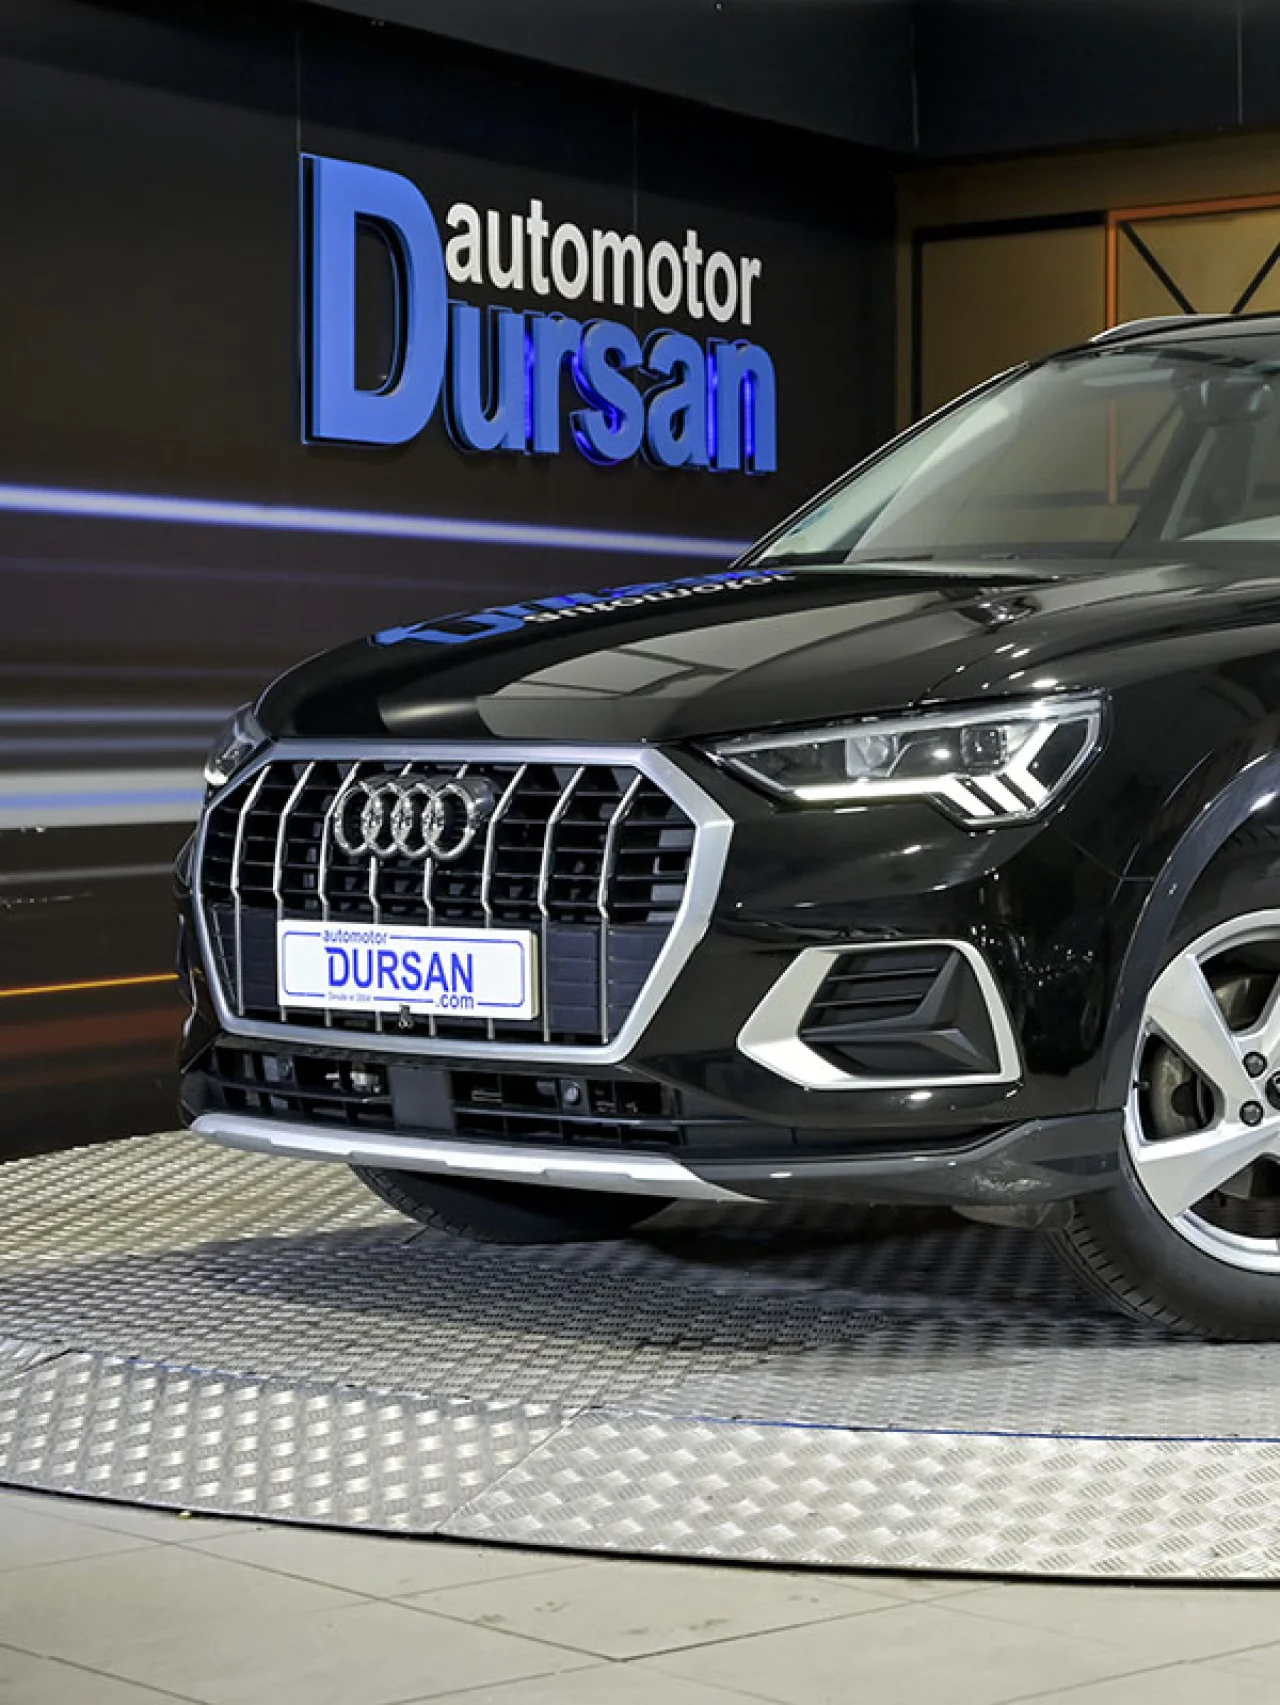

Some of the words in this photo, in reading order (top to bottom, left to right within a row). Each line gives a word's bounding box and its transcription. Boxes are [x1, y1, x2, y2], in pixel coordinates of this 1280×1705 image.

[445, 199, 761, 325] automotor
[301, 153, 777, 475] Dursan
[323, 928, 388, 946] automotor
[324, 947, 474, 993] DURSAN
[435, 993, 474, 1010] .com
